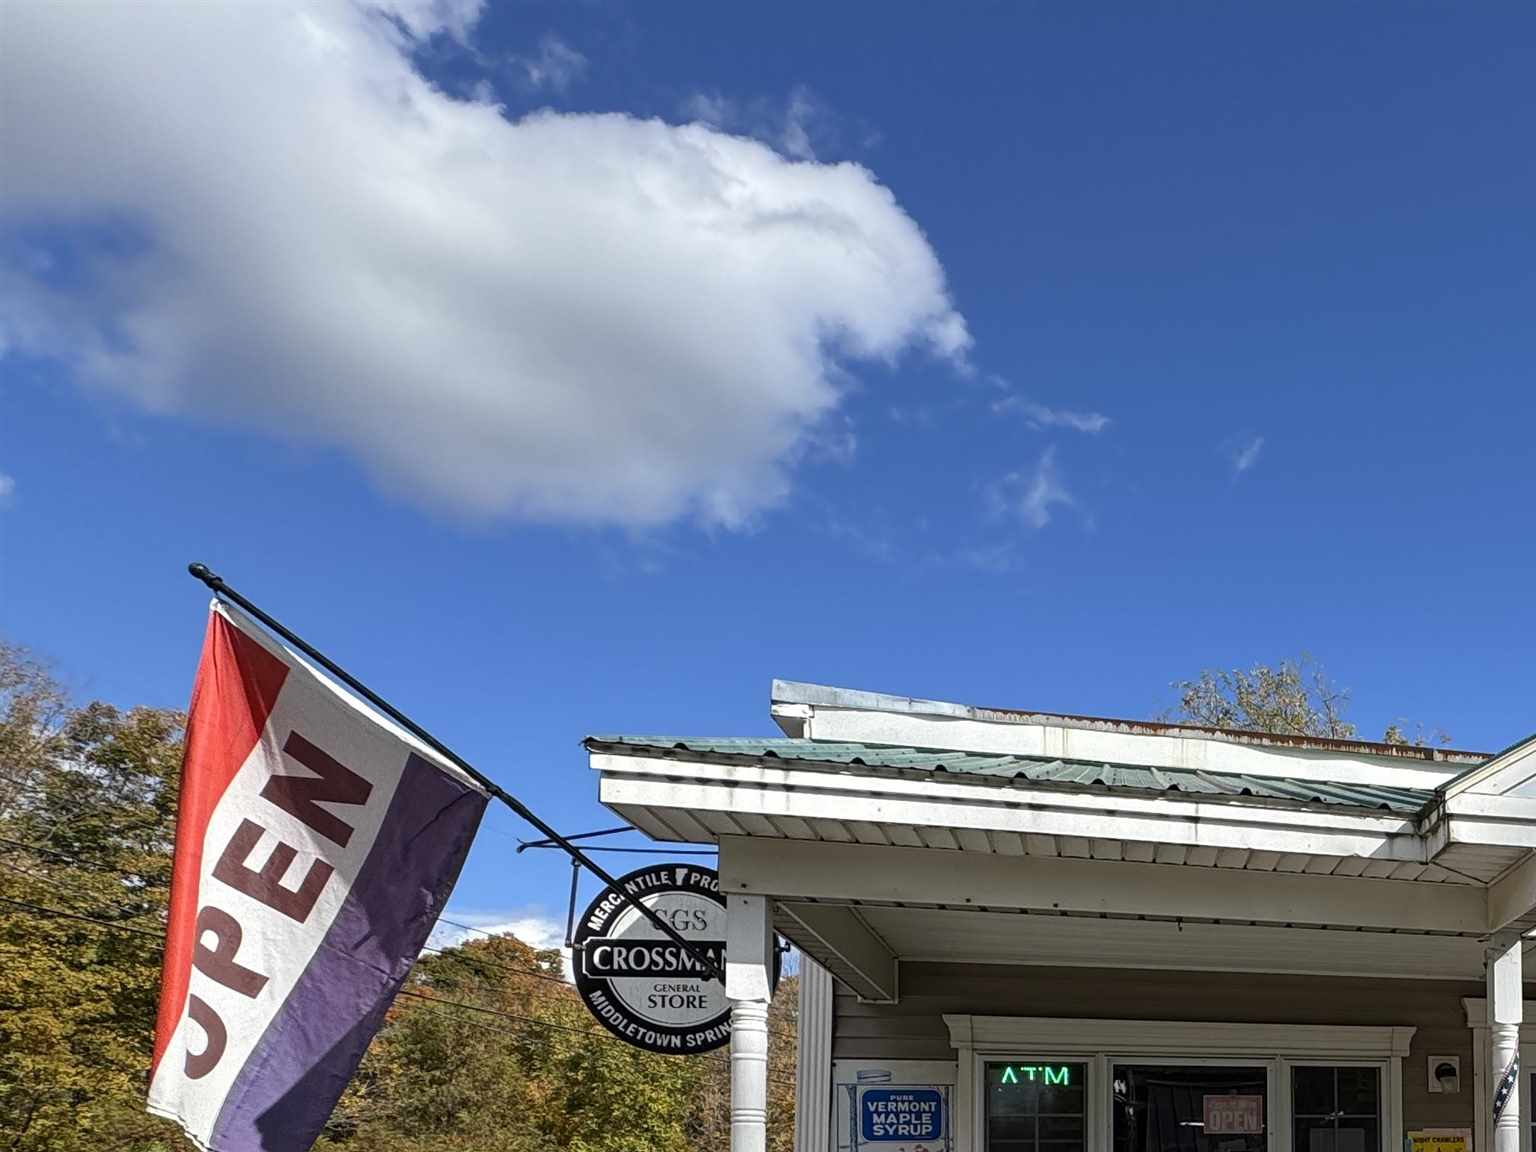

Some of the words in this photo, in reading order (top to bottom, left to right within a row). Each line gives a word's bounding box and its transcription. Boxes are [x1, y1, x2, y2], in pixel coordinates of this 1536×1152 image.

[184, 730, 374, 1080] OPEN
[654, 983, 702, 993] GENERAL
[648, 995, 708, 1009] STORE
[589, 990, 682, 1048] MIDDLETOWN
[1001, 1066, 1069, 1086] ATM
[867, 1101, 938, 1112] VERMONT
[872, 1113, 933, 1125] MAPLE
[1209, 1111, 1258, 1131] OPEN
[872, 1124, 933, 1136] SYRUP
